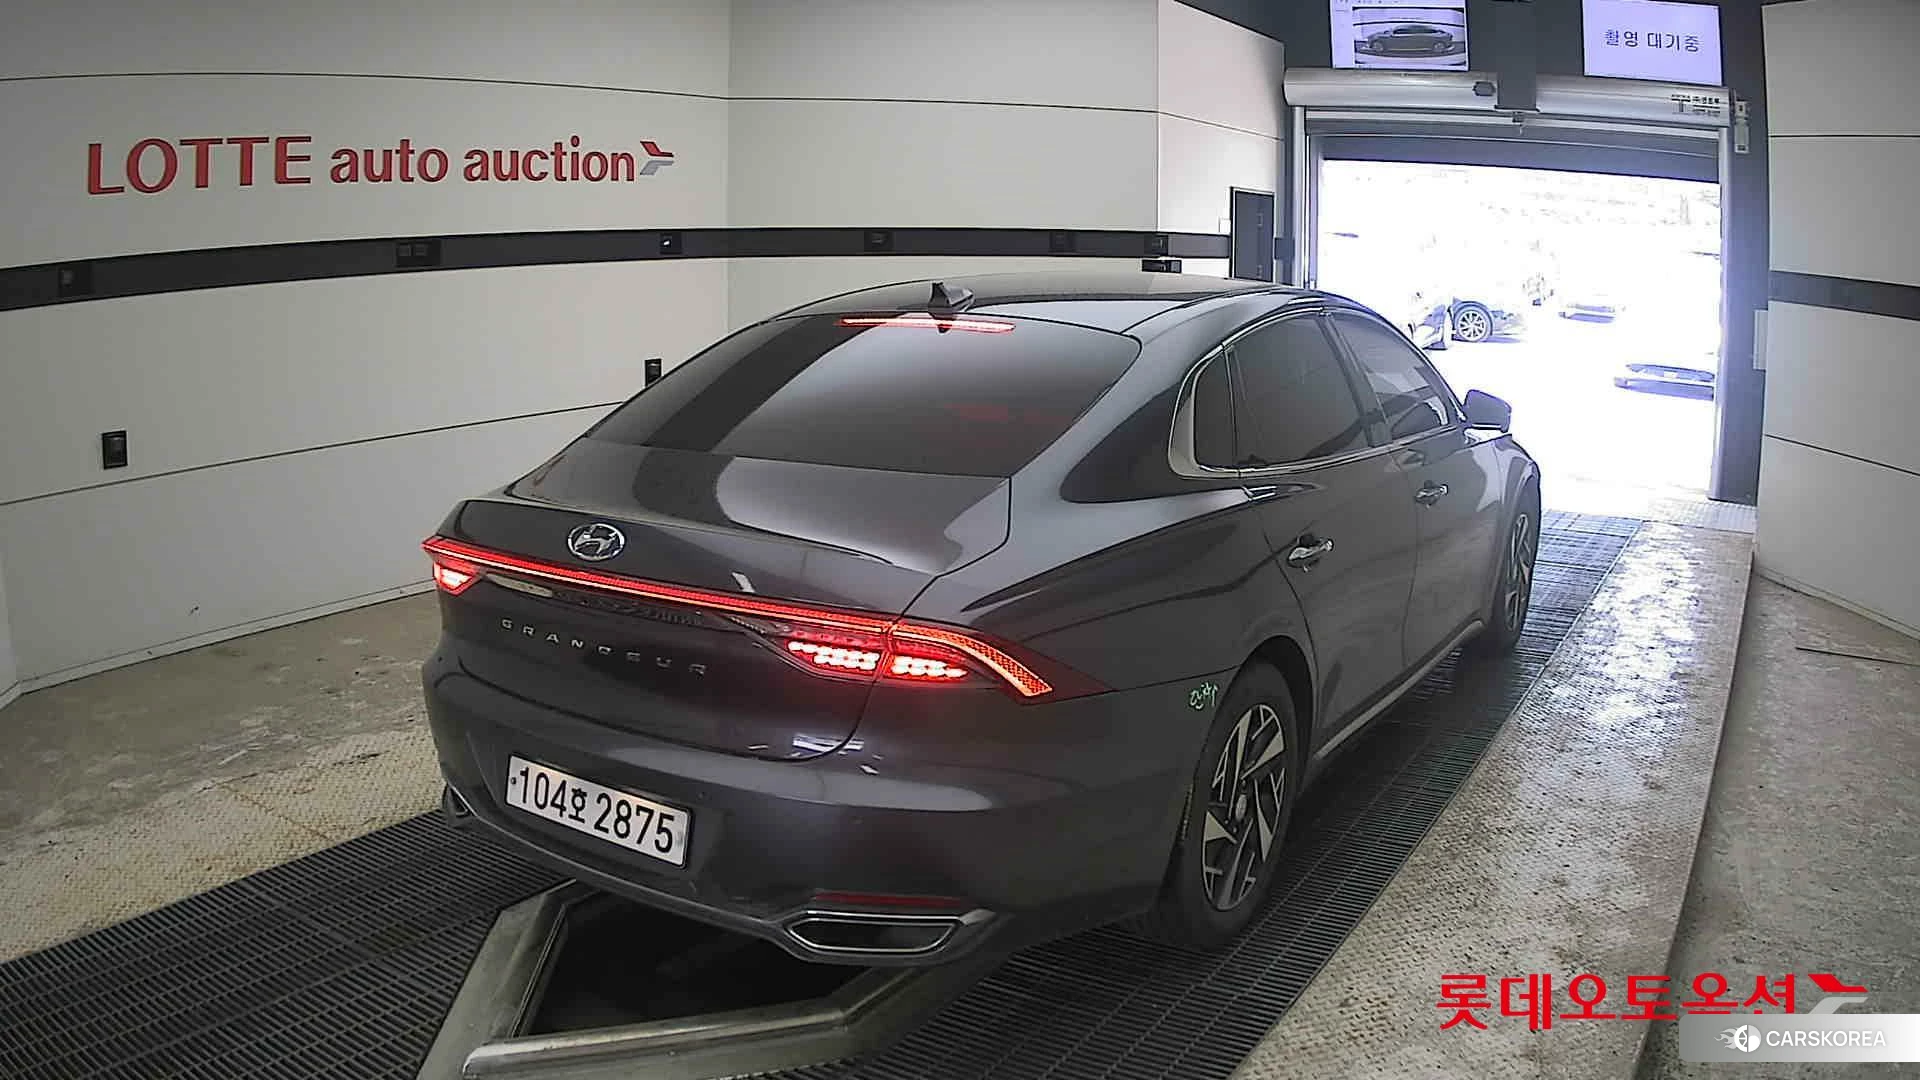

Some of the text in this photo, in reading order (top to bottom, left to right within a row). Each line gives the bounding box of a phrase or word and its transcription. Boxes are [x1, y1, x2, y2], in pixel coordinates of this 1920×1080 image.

[1647, 32, 1699, 52] 대기중
[88, 135, 635, 195] LOTTE auto auction
[501, 618, 707, 676] GRANDEUR
[519, 766, 675, 854] 104호 2875
